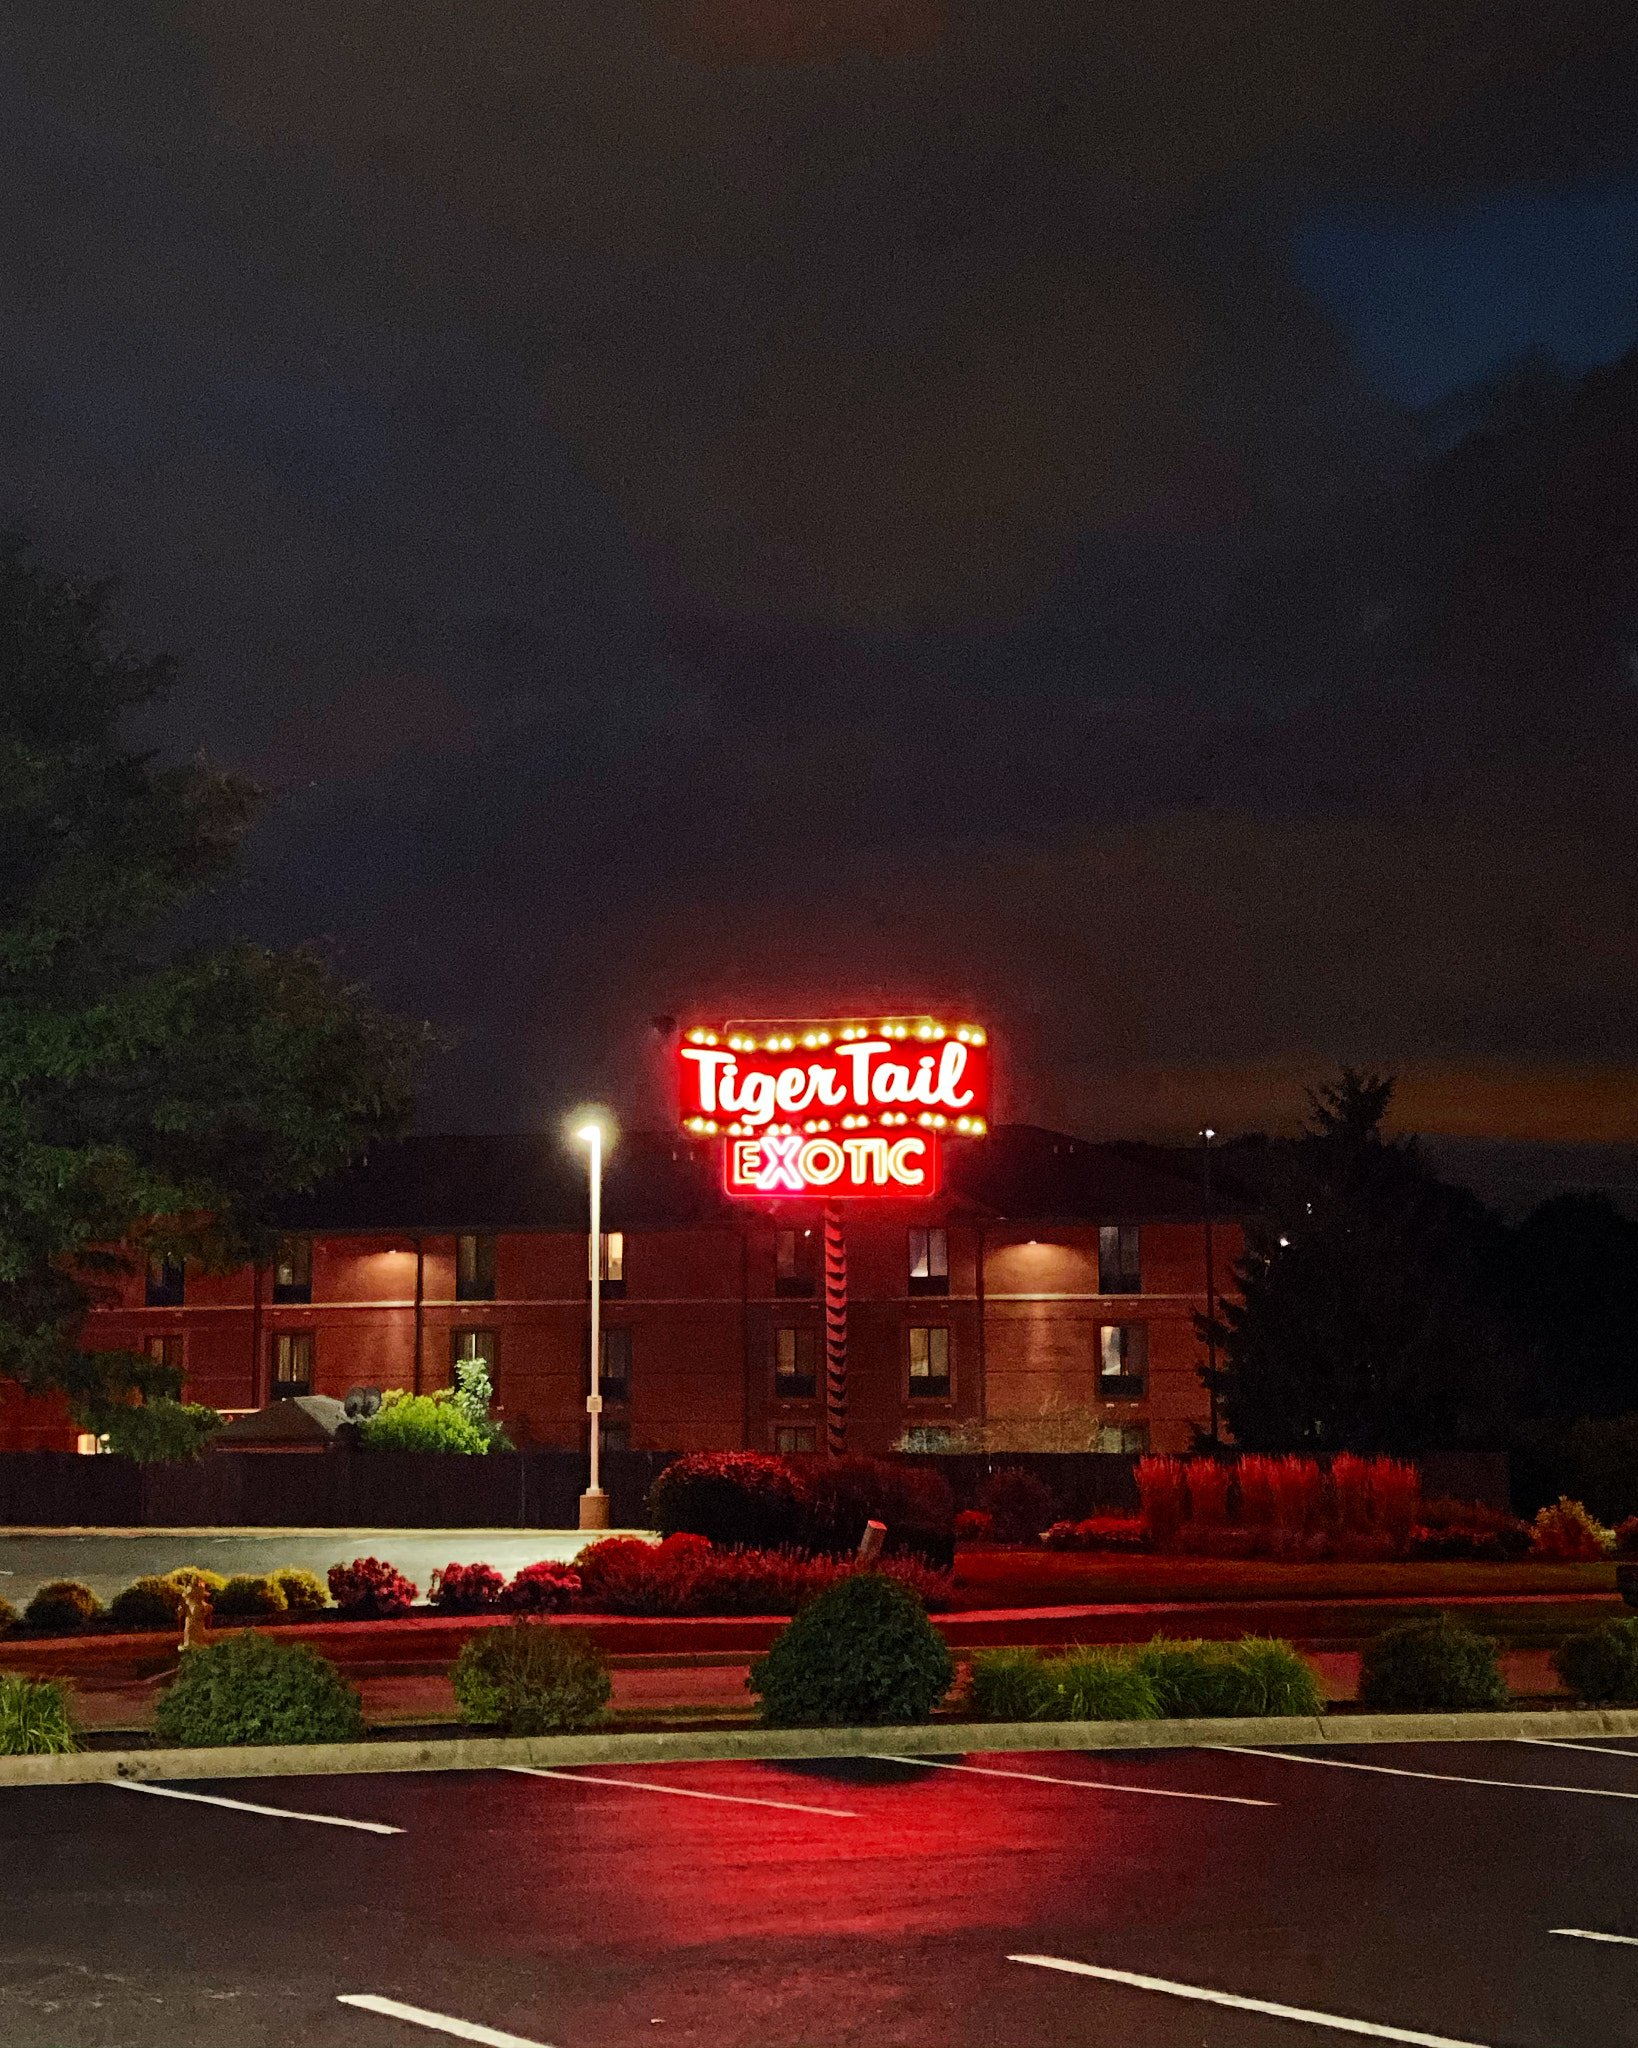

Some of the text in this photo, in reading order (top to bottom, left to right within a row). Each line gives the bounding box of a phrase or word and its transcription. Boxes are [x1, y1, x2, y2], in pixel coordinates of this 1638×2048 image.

[681, 1041, 974, 1125] Tiger Tail
[734, 1136, 926, 1189] EXOTIC
